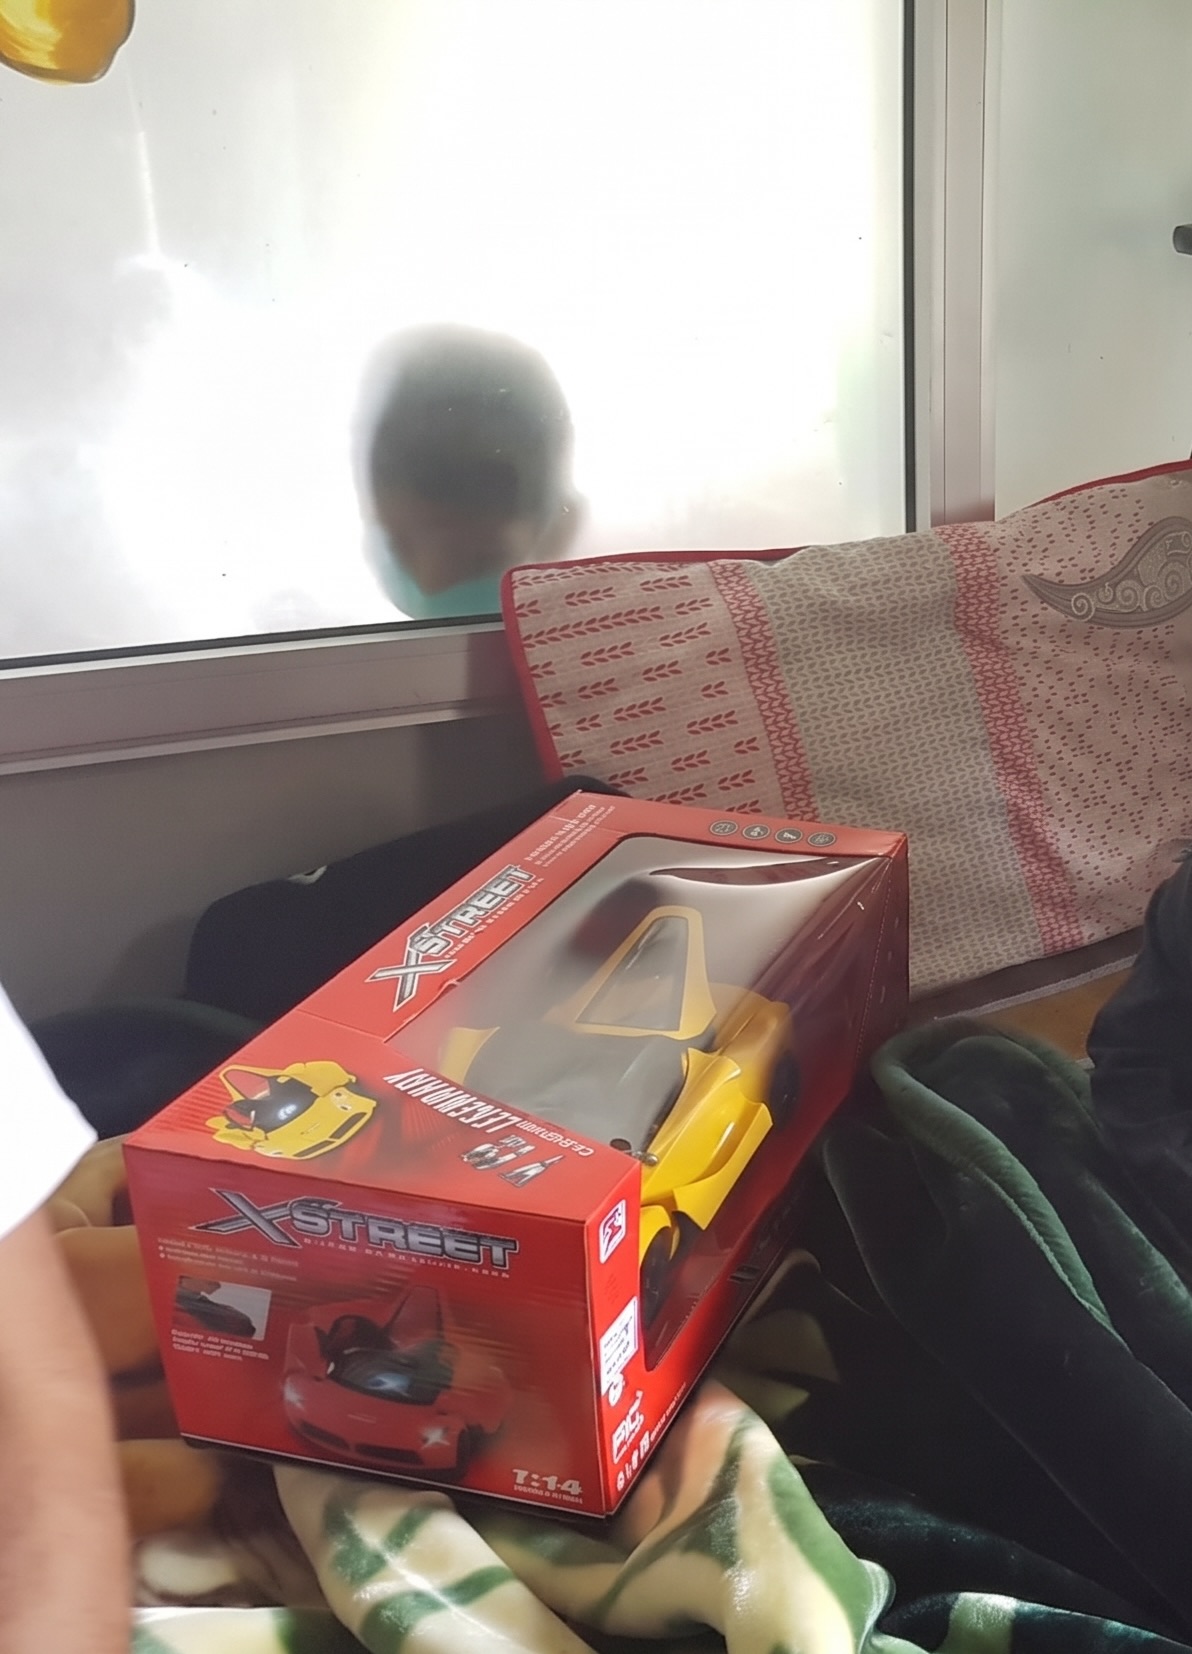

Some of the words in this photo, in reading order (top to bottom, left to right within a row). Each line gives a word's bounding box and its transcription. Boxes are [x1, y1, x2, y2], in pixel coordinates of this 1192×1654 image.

[364, 864, 536, 1013] XSTREET
[188, 1187, 519, 1270] XSTREET
[512, 1468, 583, 1496] 1:14
